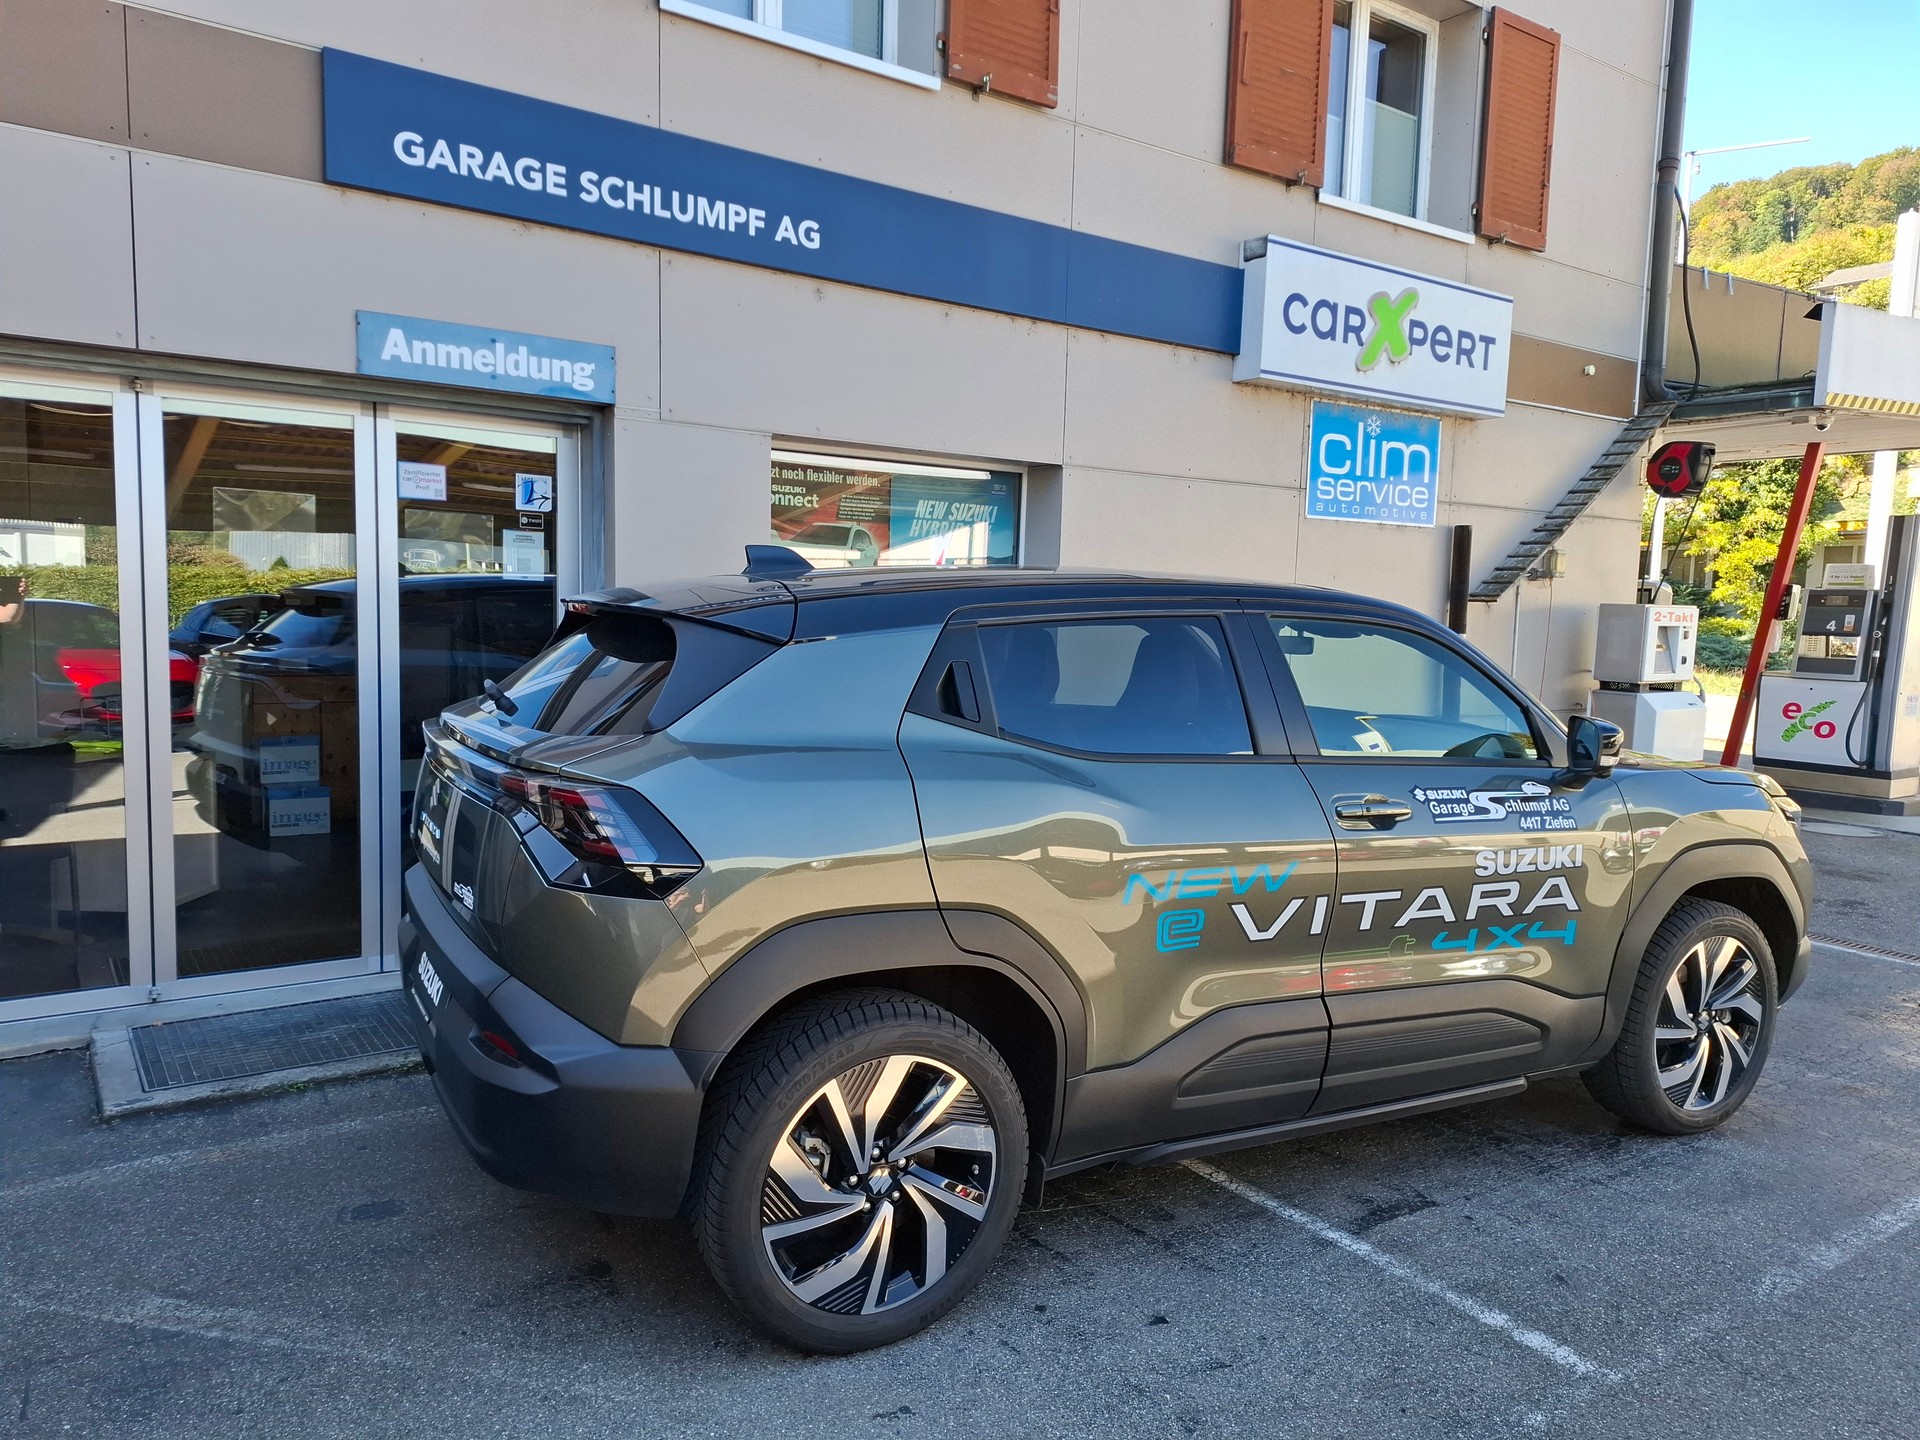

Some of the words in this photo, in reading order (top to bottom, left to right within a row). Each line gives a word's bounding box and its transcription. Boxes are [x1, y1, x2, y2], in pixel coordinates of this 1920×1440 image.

[393, 131, 568, 197] GARAGE
[579, 171, 766, 236] SCHLUMPF
[774, 216, 821, 249] AG
[380, 328, 595, 392] Anmeldung
[1319, 421, 1431, 484] clim
[782, 468, 804, 480] noch
[806, 469, 844, 484] flexibler
[846, 474, 881, 487] werden.
[771, 484, 806, 494] SUZUKI
[1316, 476, 1429, 508] service
[914, 499, 949, 520] NEW
[948, 502, 999, 524] SUZUKI
[1316, 501, 1428, 521] automotive
[1653, 611, 1694, 622] 2-Takt
[1825, 620, 1837, 631] 4
[263, 758, 317, 773] image
[1426, 789, 1468, 800] SUZUKI
[1429, 801, 1475, 816] Garage
[1551, 799, 1570, 812] AG
[271, 811, 328, 825] image
[1520, 816, 1542, 830] 4417
[1544, 815, 1576, 829] Ziefen
[1474, 844, 1584, 878] SUZUKI
[1122, 861, 1301, 906] NEW
[1228, 875, 1583, 943] VITARA
[417, 951, 444, 1007] SUZUKI
